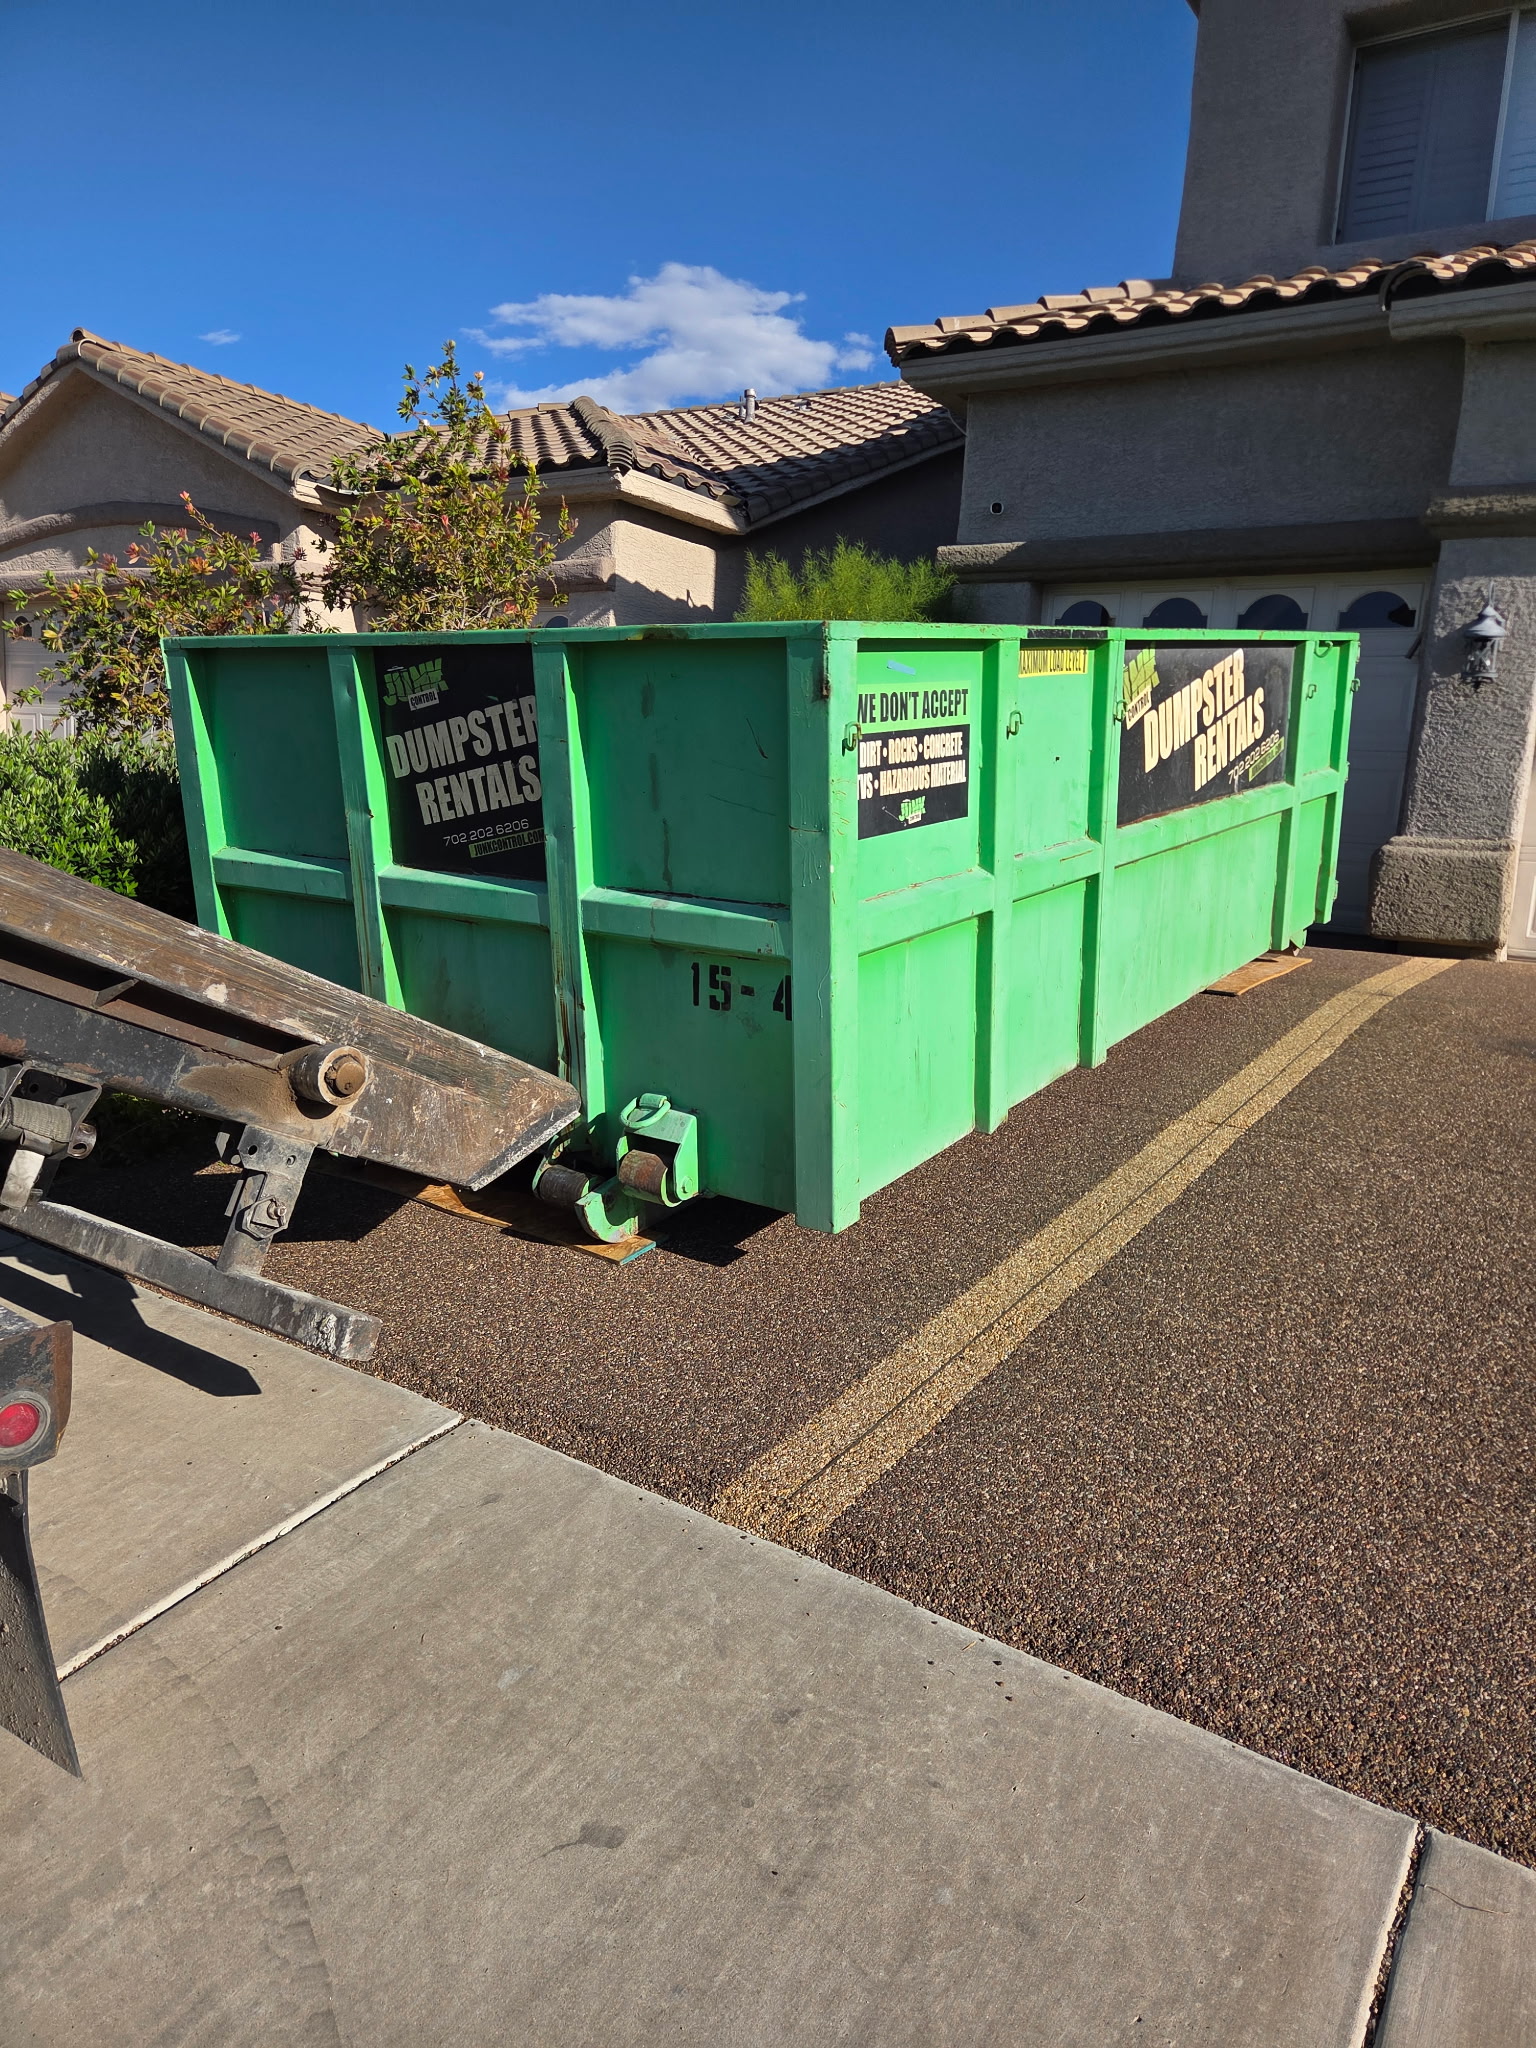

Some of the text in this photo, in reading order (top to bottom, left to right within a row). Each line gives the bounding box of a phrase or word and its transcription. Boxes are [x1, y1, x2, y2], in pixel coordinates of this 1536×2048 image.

[1050, 648, 1064, 672] LOAD
[1065, 648, 1081, 671] LEVEL
[383, 658, 449, 706] JUNK
[410, 690, 437, 707] CONTROL
[880, 691, 919, 722] DON'T
[922, 688, 968, 719] ACCEPT
[1127, 691, 1150, 721] CONTROL
[1144, 648, 1245, 773] DUMPSTER
[386, 695, 538, 779] DUMPSTER
[860, 731, 963, 768] DIRT ROCKS CONCRETE
[1194, 687, 1265, 791] RENTALS
[415, 755, 543, 825] RENTALS
[880, 764, 930, 796] HAZARDOUS
[930, 759, 967, 788] MATERIAL
[443, 818, 529, 846] 702.202.6206
